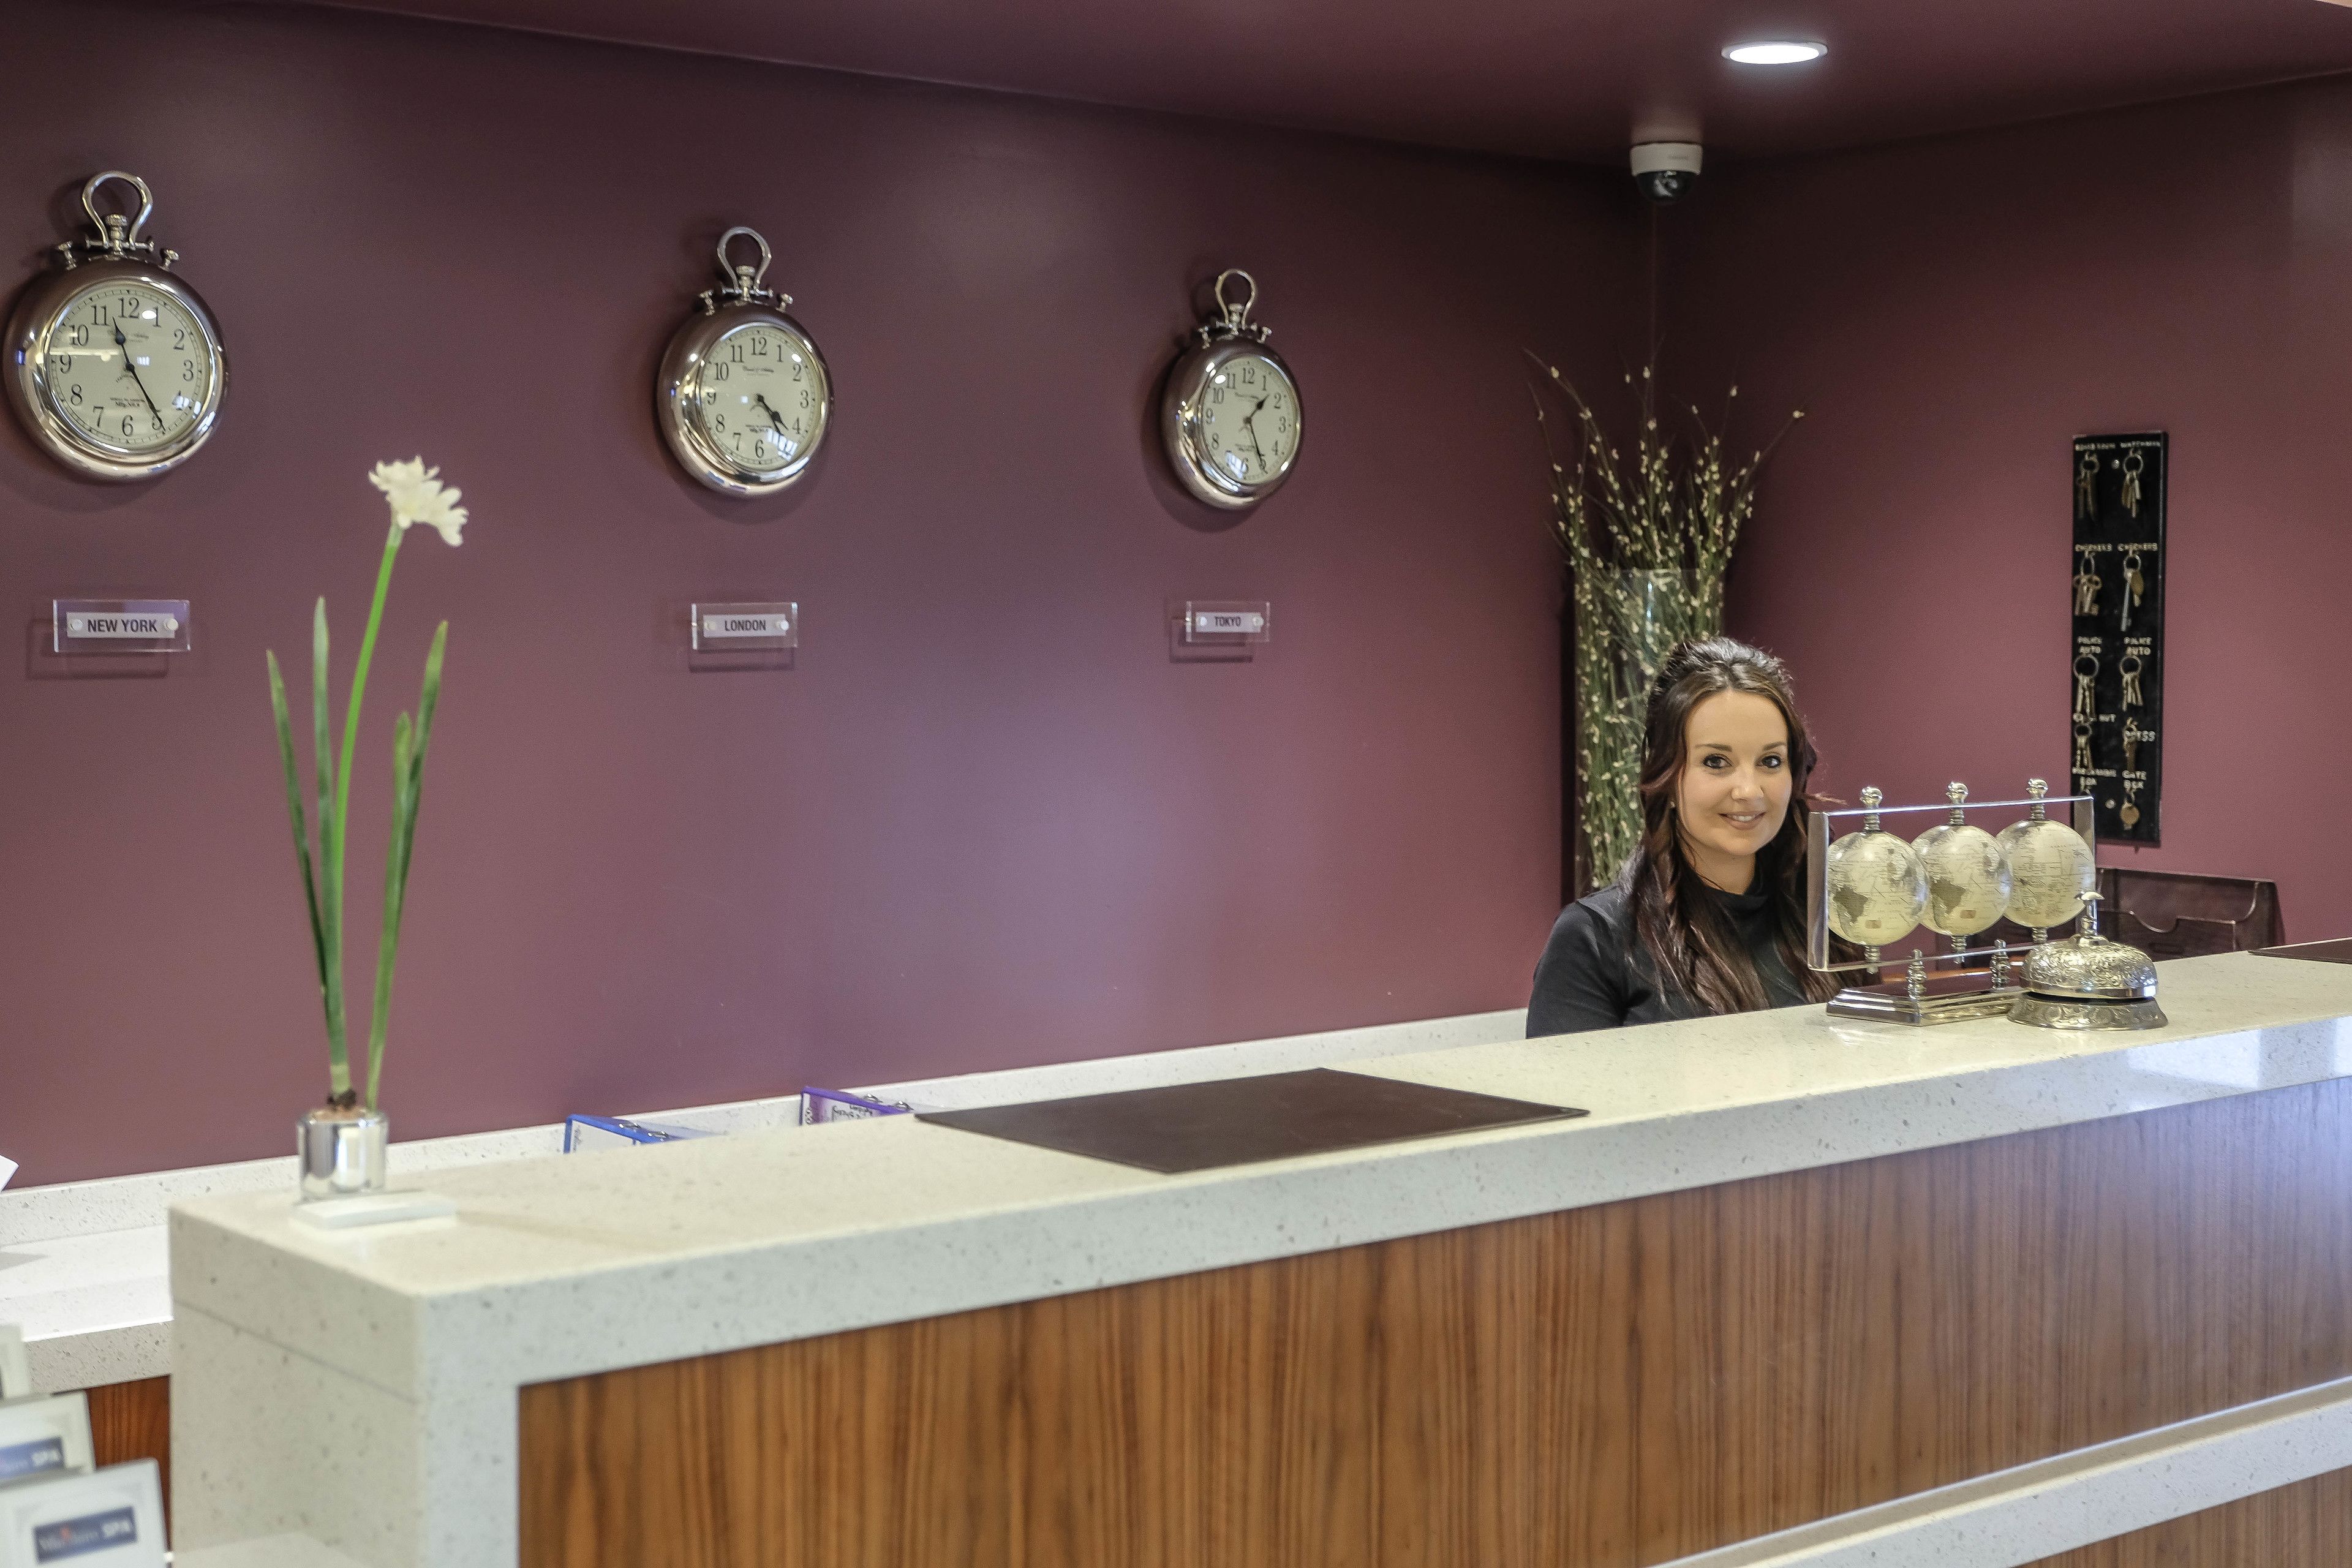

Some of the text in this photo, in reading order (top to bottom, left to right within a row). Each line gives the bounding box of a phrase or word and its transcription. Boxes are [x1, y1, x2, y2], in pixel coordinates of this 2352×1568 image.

[91, 304, 110, 326] 11
[118, 297, 140, 319] 12
[153, 306, 162, 328] 1
[173, 328, 185, 350] 2
[750, 337, 767, 356] 12
[730, 344, 744, 363] 11
[776, 344, 784, 363] 1
[60, 353, 72, 374] 9
[183, 360, 194, 382] 3
[714, 362, 729, 381] 10
[793, 363, 802, 382] 2
[1226, 373, 1236, 390] 11
[1242, 368, 1255, 384] 12
[1262, 375, 1267, 391] 1
[70, 384, 83, 406] 8
[707, 390, 717, 405] 9
[799, 390, 809, 409] 3
[1213, 387, 1224, 404] 10
[1273, 392, 1281, 409] 2
[92, 405, 105, 428] 7
[715, 413, 725, 433] 8
[1205, 407, 1213, 424] 9
[1278, 416, 1286, 433] 3
[122, 415, 134, 437] 6
[792, 417, 801, 434] 4
[732, 432, 741, 451] 7
[755, 439, 764, 458] 6
[1212, 432, 1219, 450] 8
[1272, 440, 1279, 456] 4
[87, 619, 158, 633] NEW YORK
[724, 619, 767, 631] LONDON
[1215, 616, 1242, 627] TOKYO
